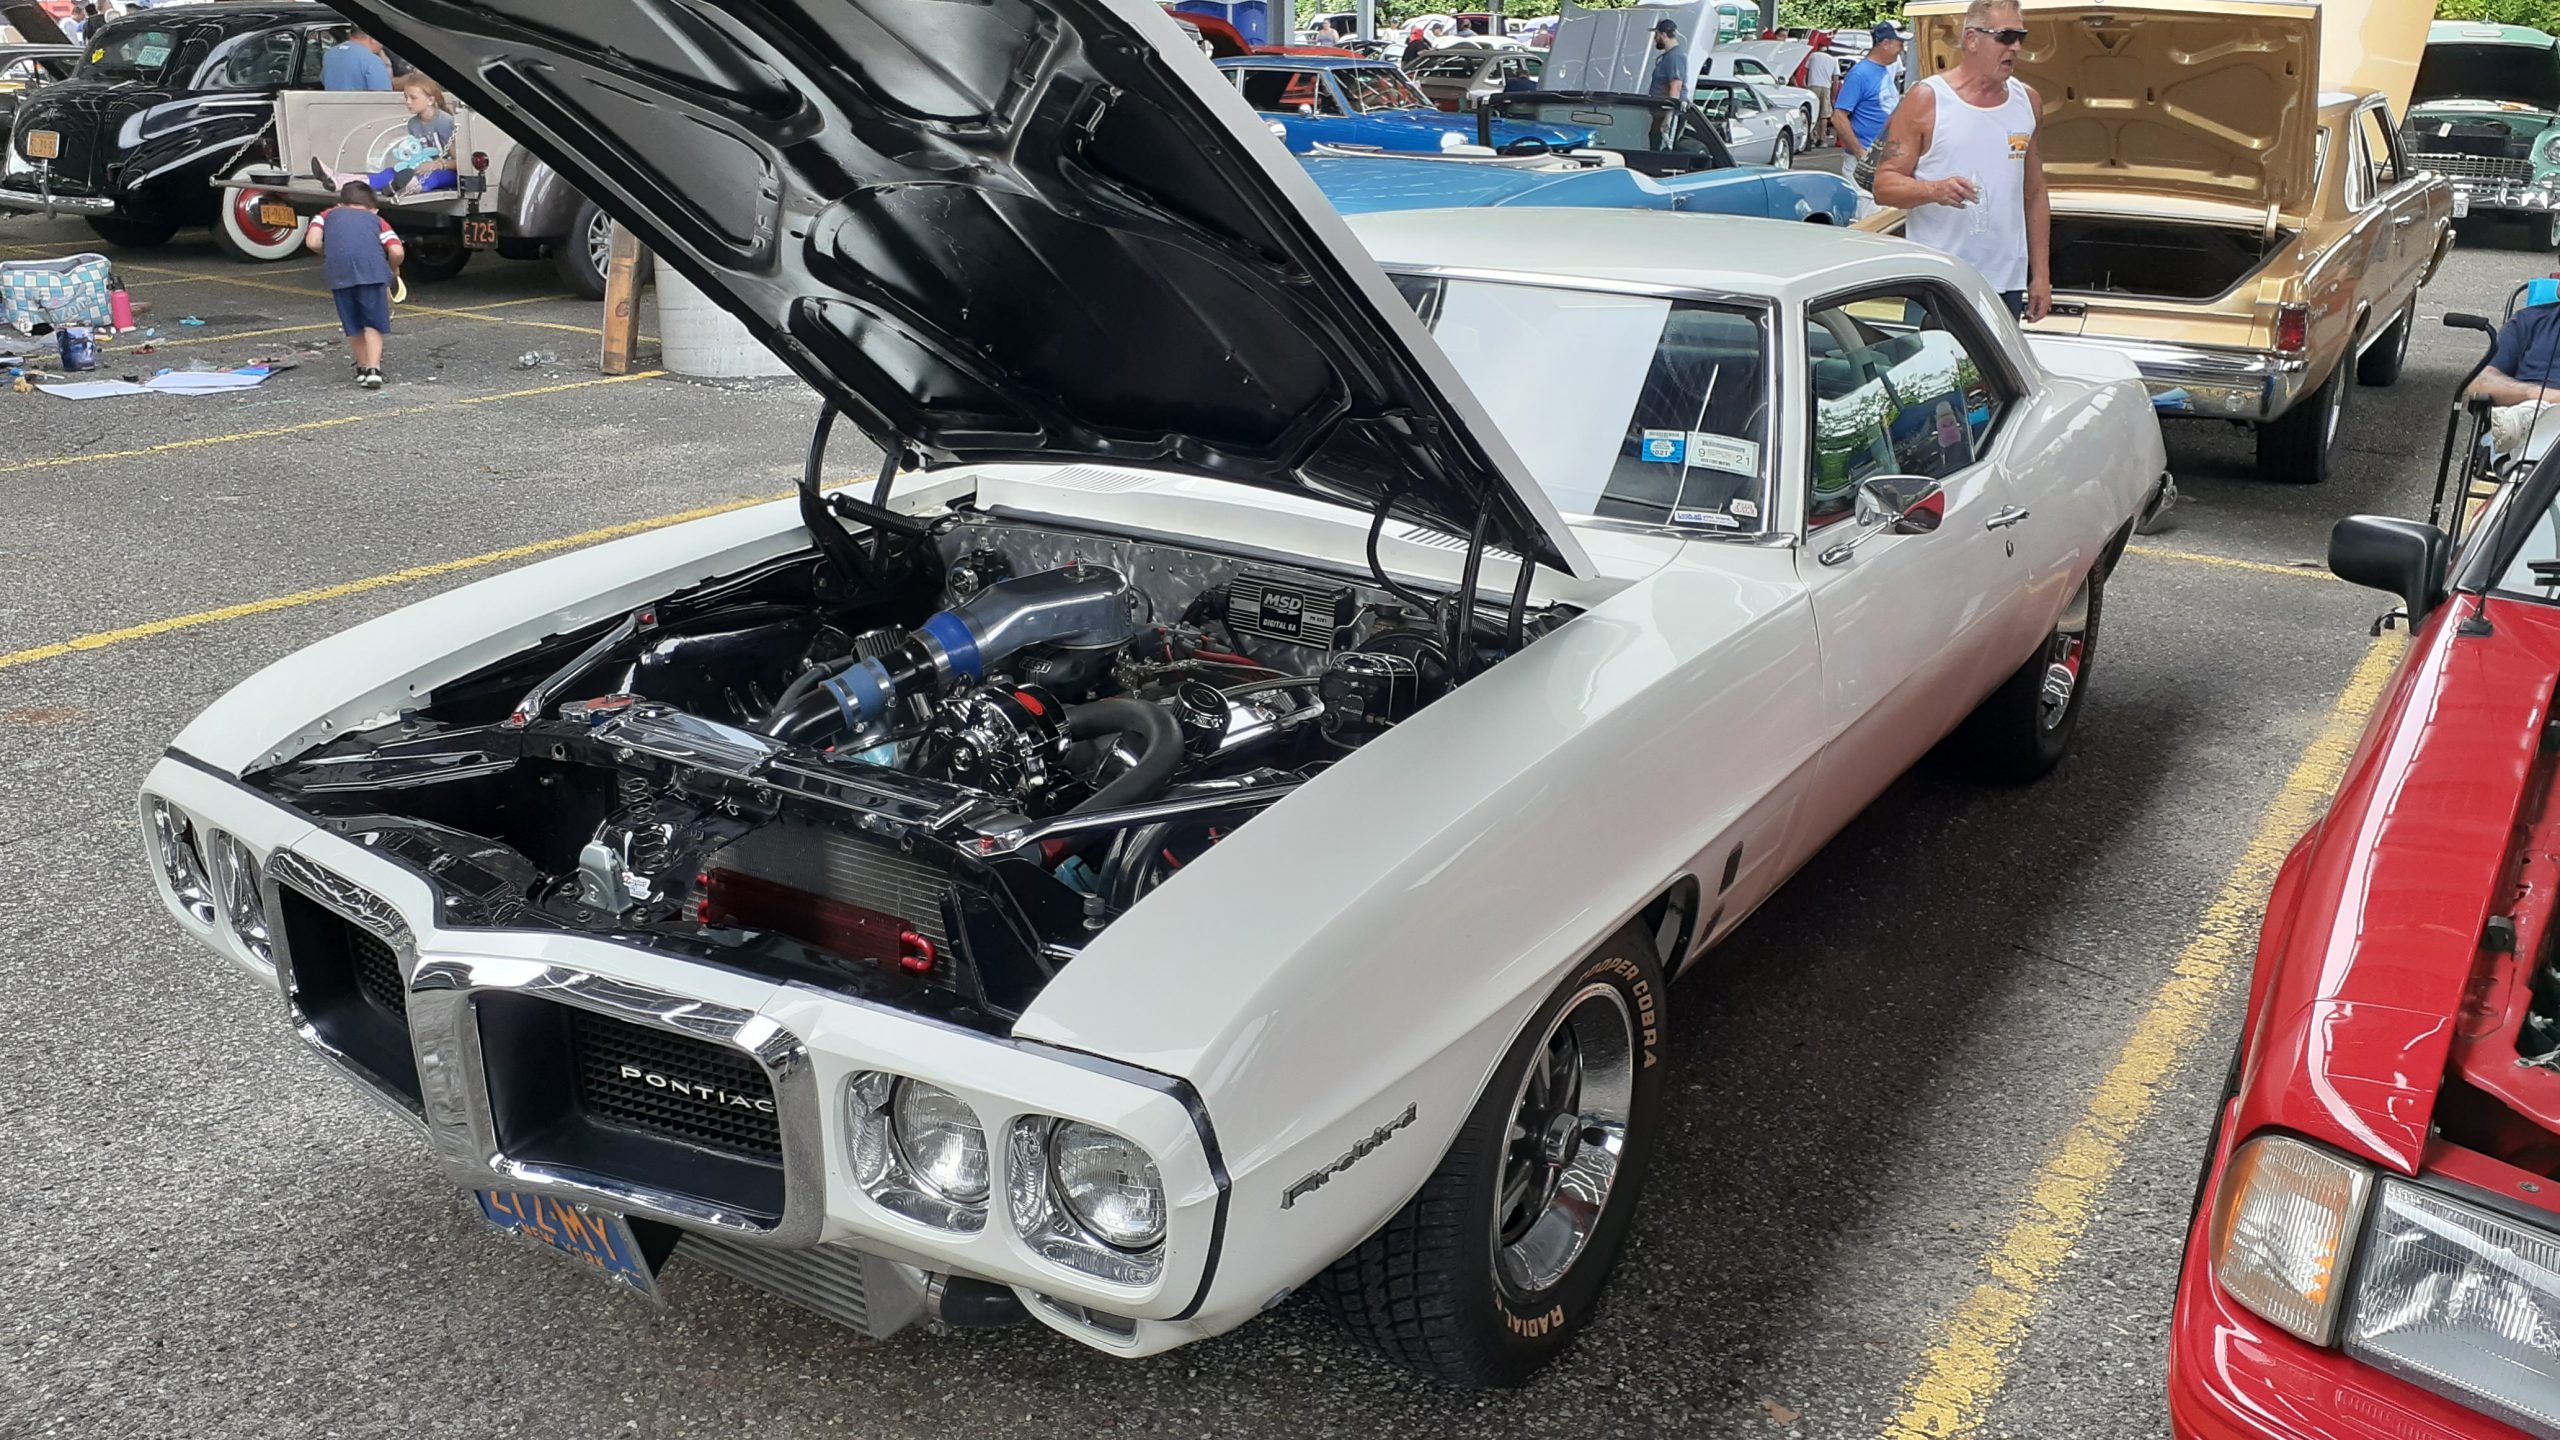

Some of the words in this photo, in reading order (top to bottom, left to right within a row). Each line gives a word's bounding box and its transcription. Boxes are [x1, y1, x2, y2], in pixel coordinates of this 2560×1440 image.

[471, 222, 496, 242] 725
[1698, 448, 1706, 458] 9
[1736, 454, 1751, 466] 21
[1263, 593, 1302, 610] MSD
[1262, 618, 1287, 630] DIGITAL
[1632, 980, 1657, 1068] COBRA
[620, 1065, 776, 1113] PONTIAC
[1280, 1101, 1417, 1210] Firebird
[521, 1222, 555, 1246] NEW
[562, 1241, 604, 1268] YORK
[1504, 1304, 1565, 1338] RADIAL
